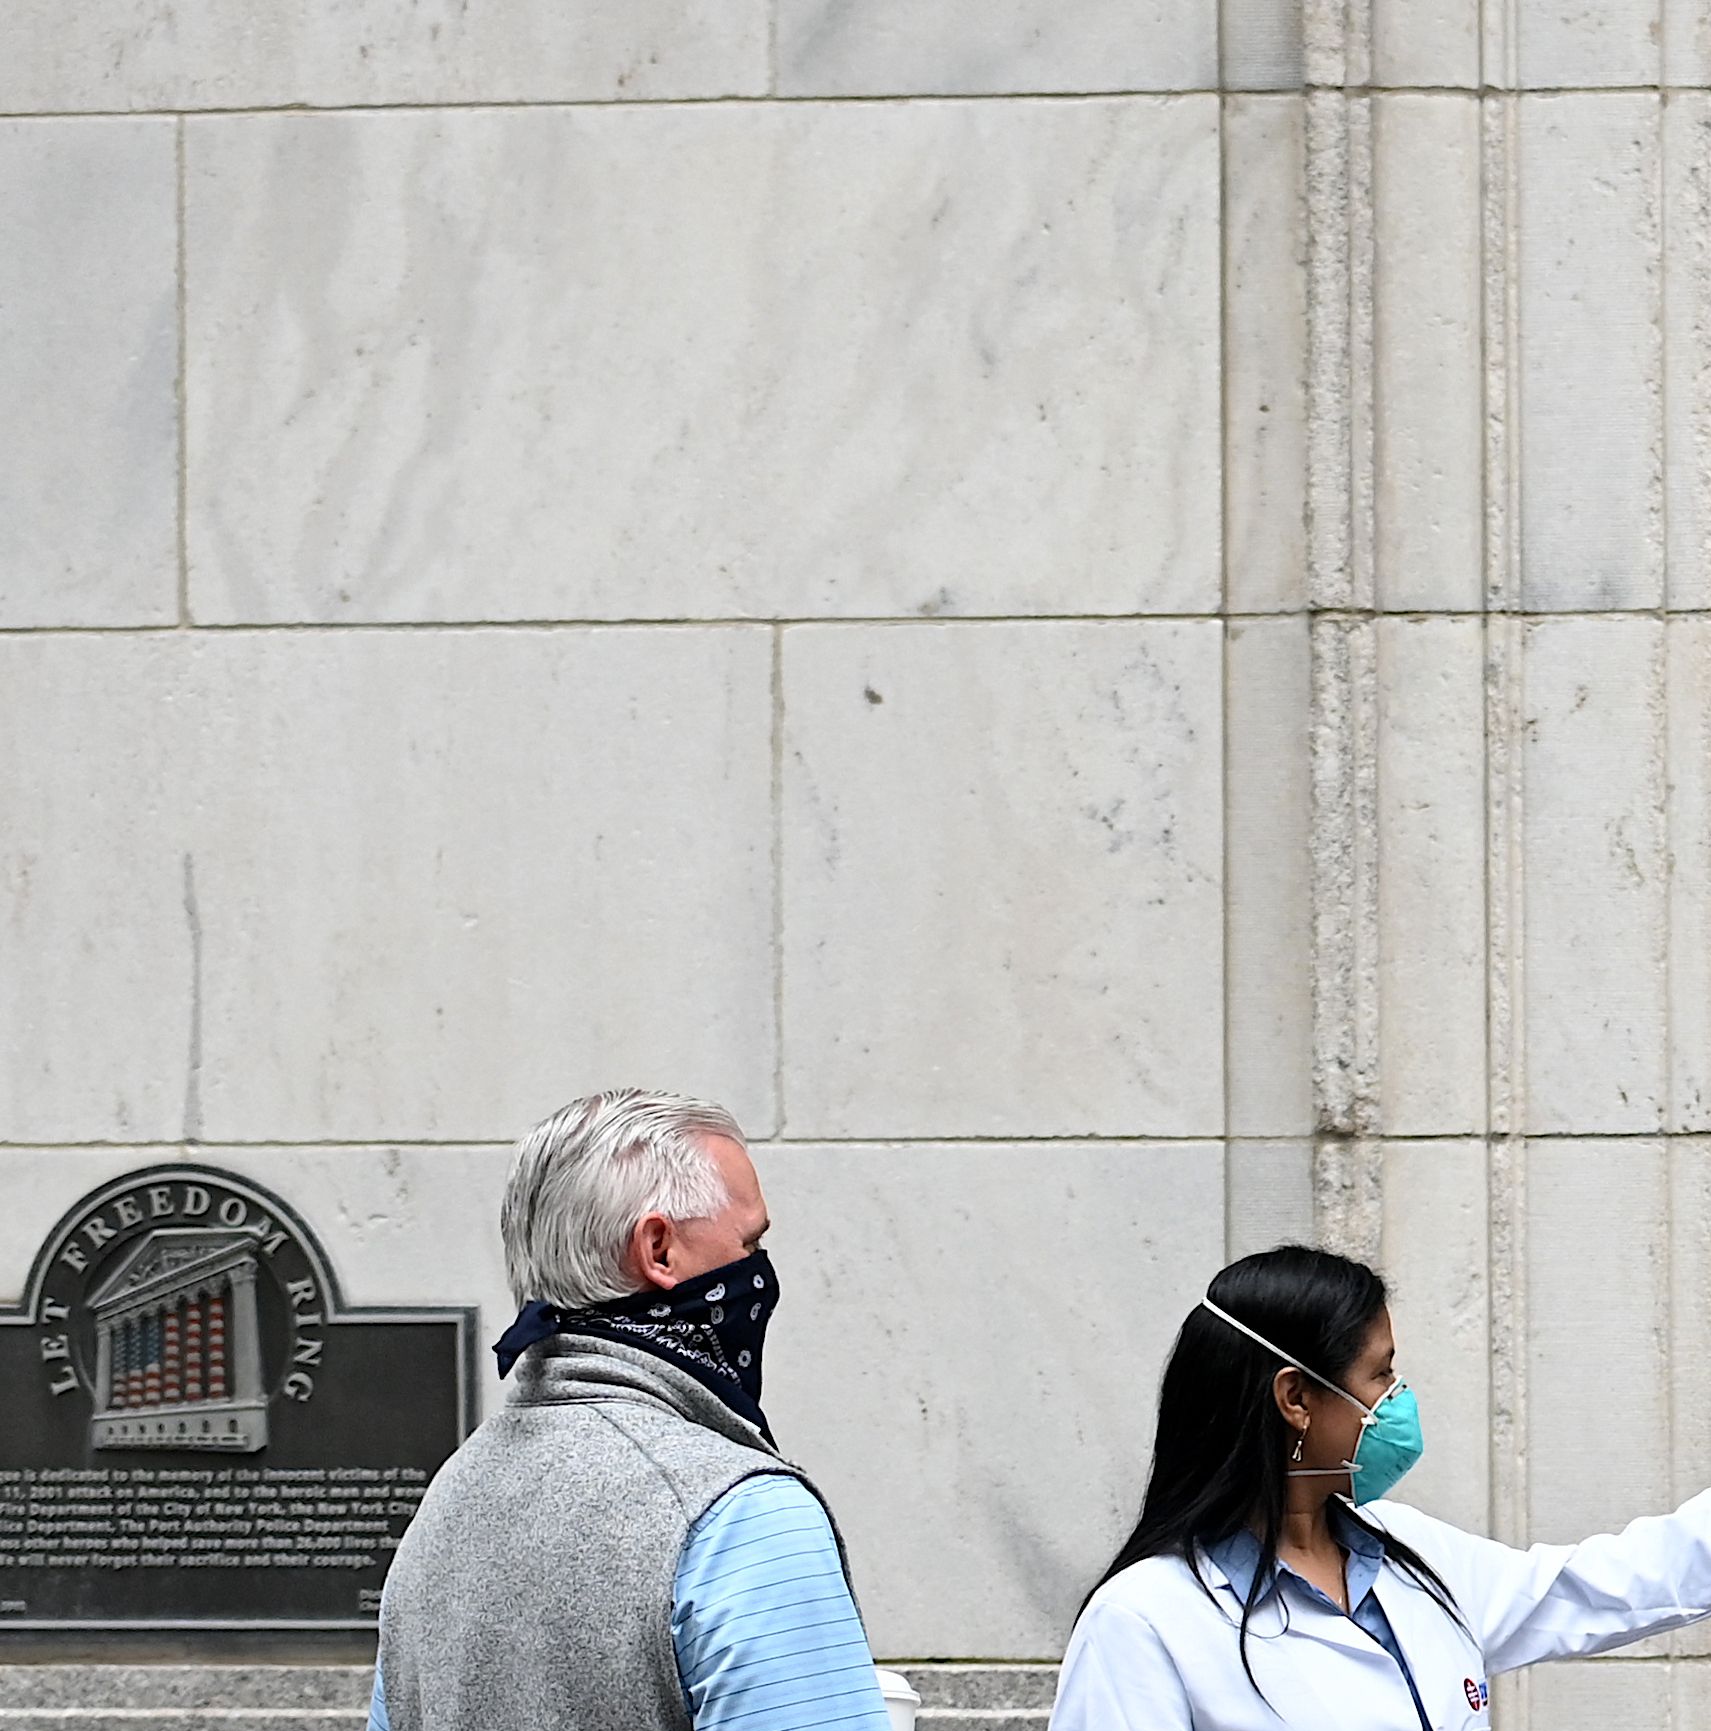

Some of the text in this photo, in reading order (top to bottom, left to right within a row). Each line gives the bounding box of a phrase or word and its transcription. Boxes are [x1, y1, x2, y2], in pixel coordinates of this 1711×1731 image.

[41, 1184, 325, 1403] LET FREEDOM RING
[40, 1469, 109, 1482] dedicated
[131, 1469, 154, 1482] the
[236, 1469, 260, 1481] the
[403, 1468, 426, 1481] the
[67, 1486, 113, 1498] attack
[204, 1486, 230, 1498] and
[253, 1486, 278, 1498] the
[364, 1486, 390, 1498] and
[135, 1502, 160, 1514] the
[164, 1502, 192, 1518] City
[290, 1502, 314, 1514] the
[351, 1502, 384, 1514] York
[120, 1519, 145, 1532] The
